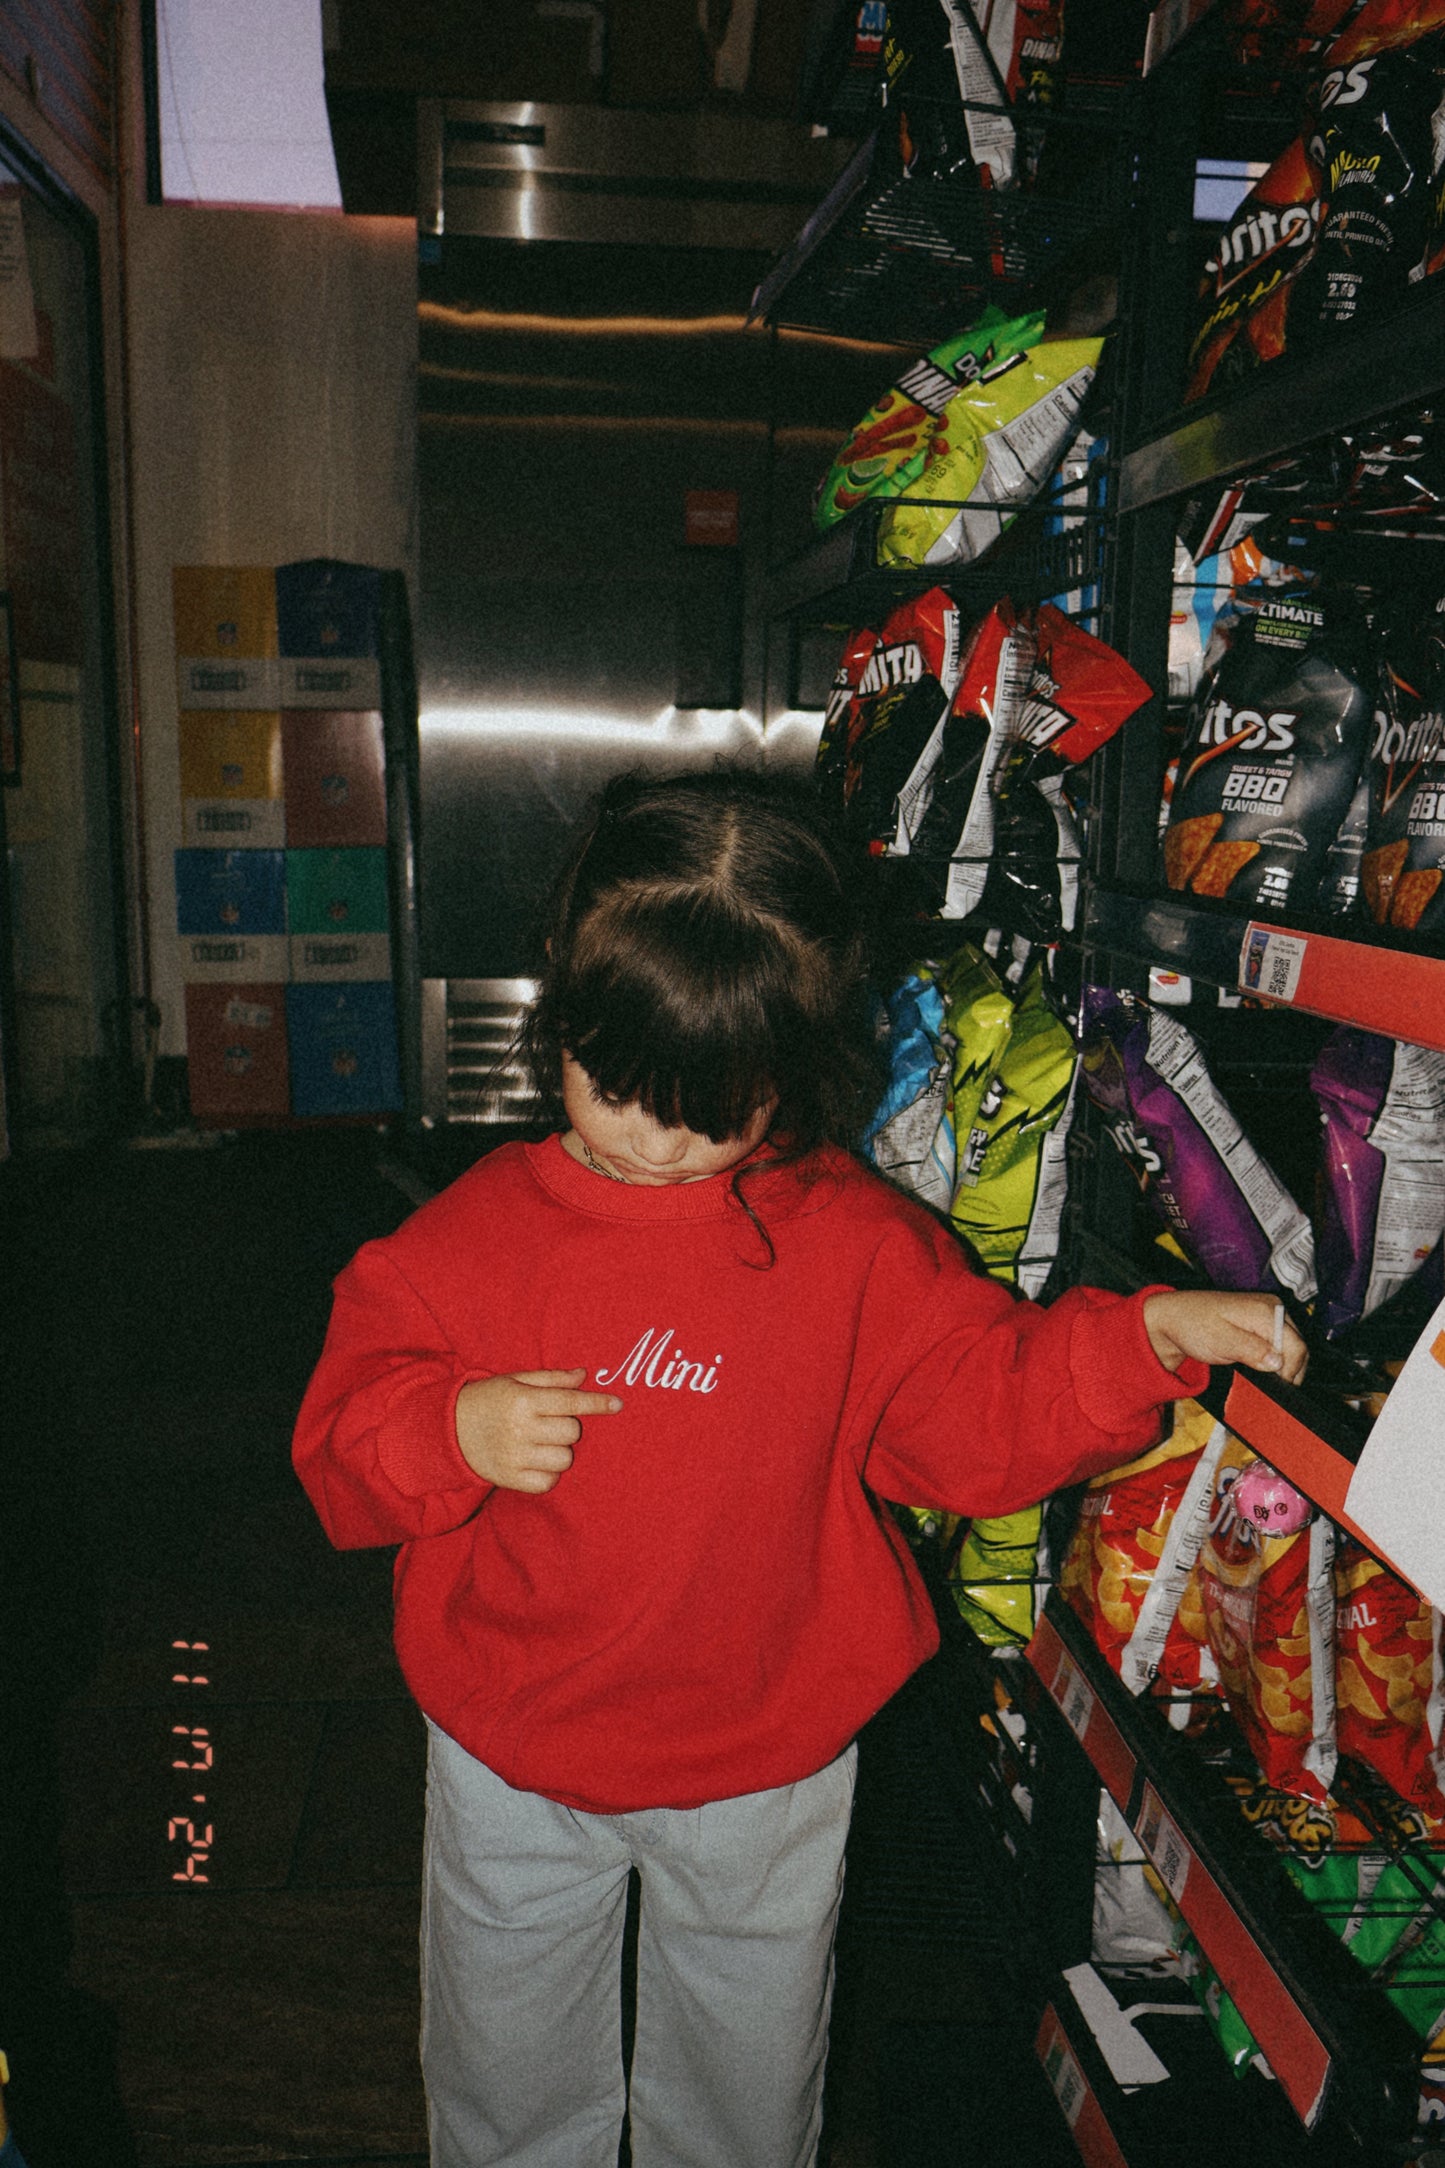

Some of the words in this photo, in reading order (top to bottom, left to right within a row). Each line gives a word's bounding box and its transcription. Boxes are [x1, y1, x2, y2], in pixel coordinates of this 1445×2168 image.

[1325, 210, 1376, 231] UARANTEED
[1259, 602, 1324, 626] LTIMATE
[1222, 773, 1288, 803] BBQ
[1221, 798, 1284, 817] FLAVORED
[595, 1327, 722, 1394] Mini
